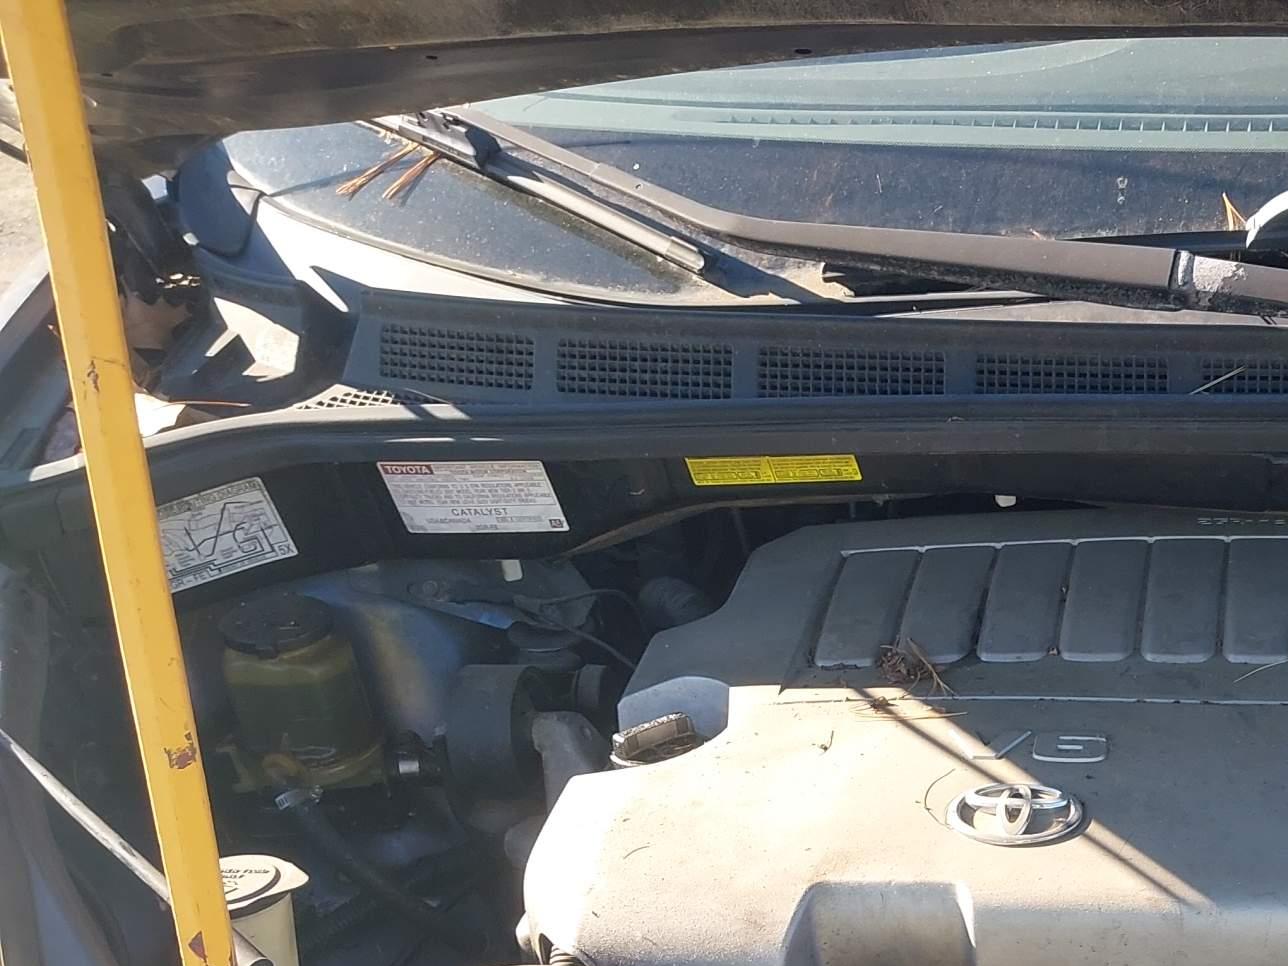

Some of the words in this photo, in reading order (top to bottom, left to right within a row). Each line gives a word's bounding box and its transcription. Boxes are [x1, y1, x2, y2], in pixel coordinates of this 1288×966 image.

[384, 464, 431, 475] TOYOTA
[451, 507, 508, 516] CATALYST
[278, 544, 294, 556] 5X
[948, 730, 1108, 763] V6
